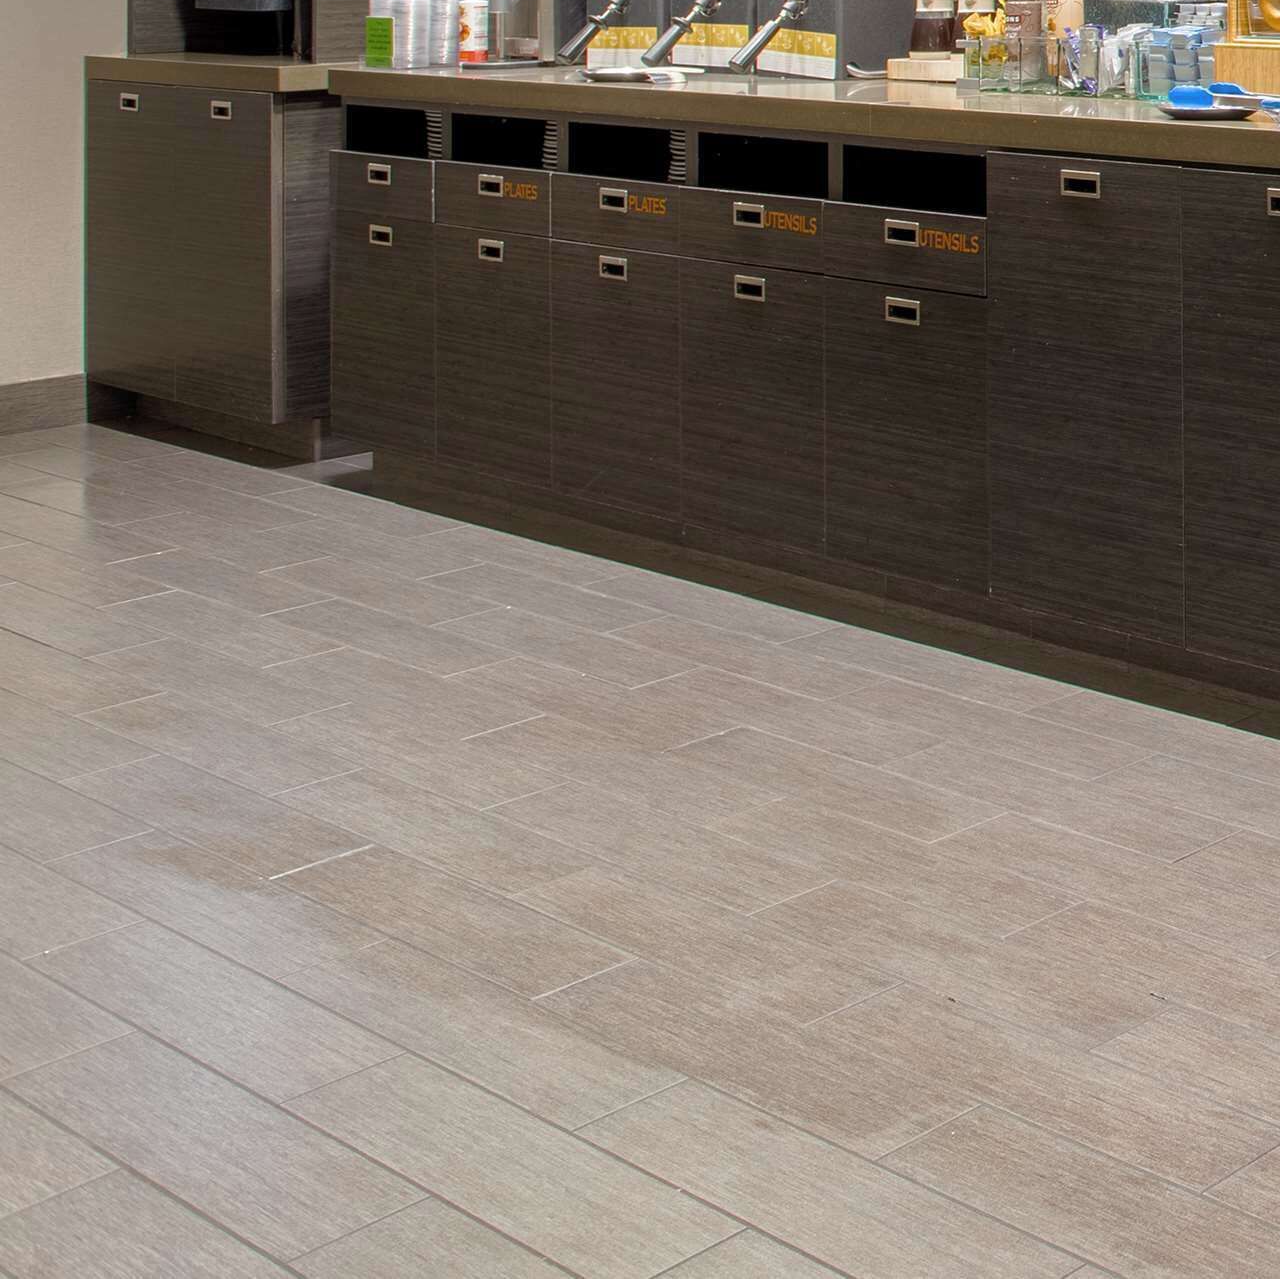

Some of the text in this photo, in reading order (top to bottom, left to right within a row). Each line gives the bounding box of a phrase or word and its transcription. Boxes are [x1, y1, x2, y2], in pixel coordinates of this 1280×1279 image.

[504, 182, 537, 200] PLATES
[628, 194, 667, 214] PLATES
[764, 210, 817, 235] UTENSILS
[919, 229, 980, 254] UTENSILS
